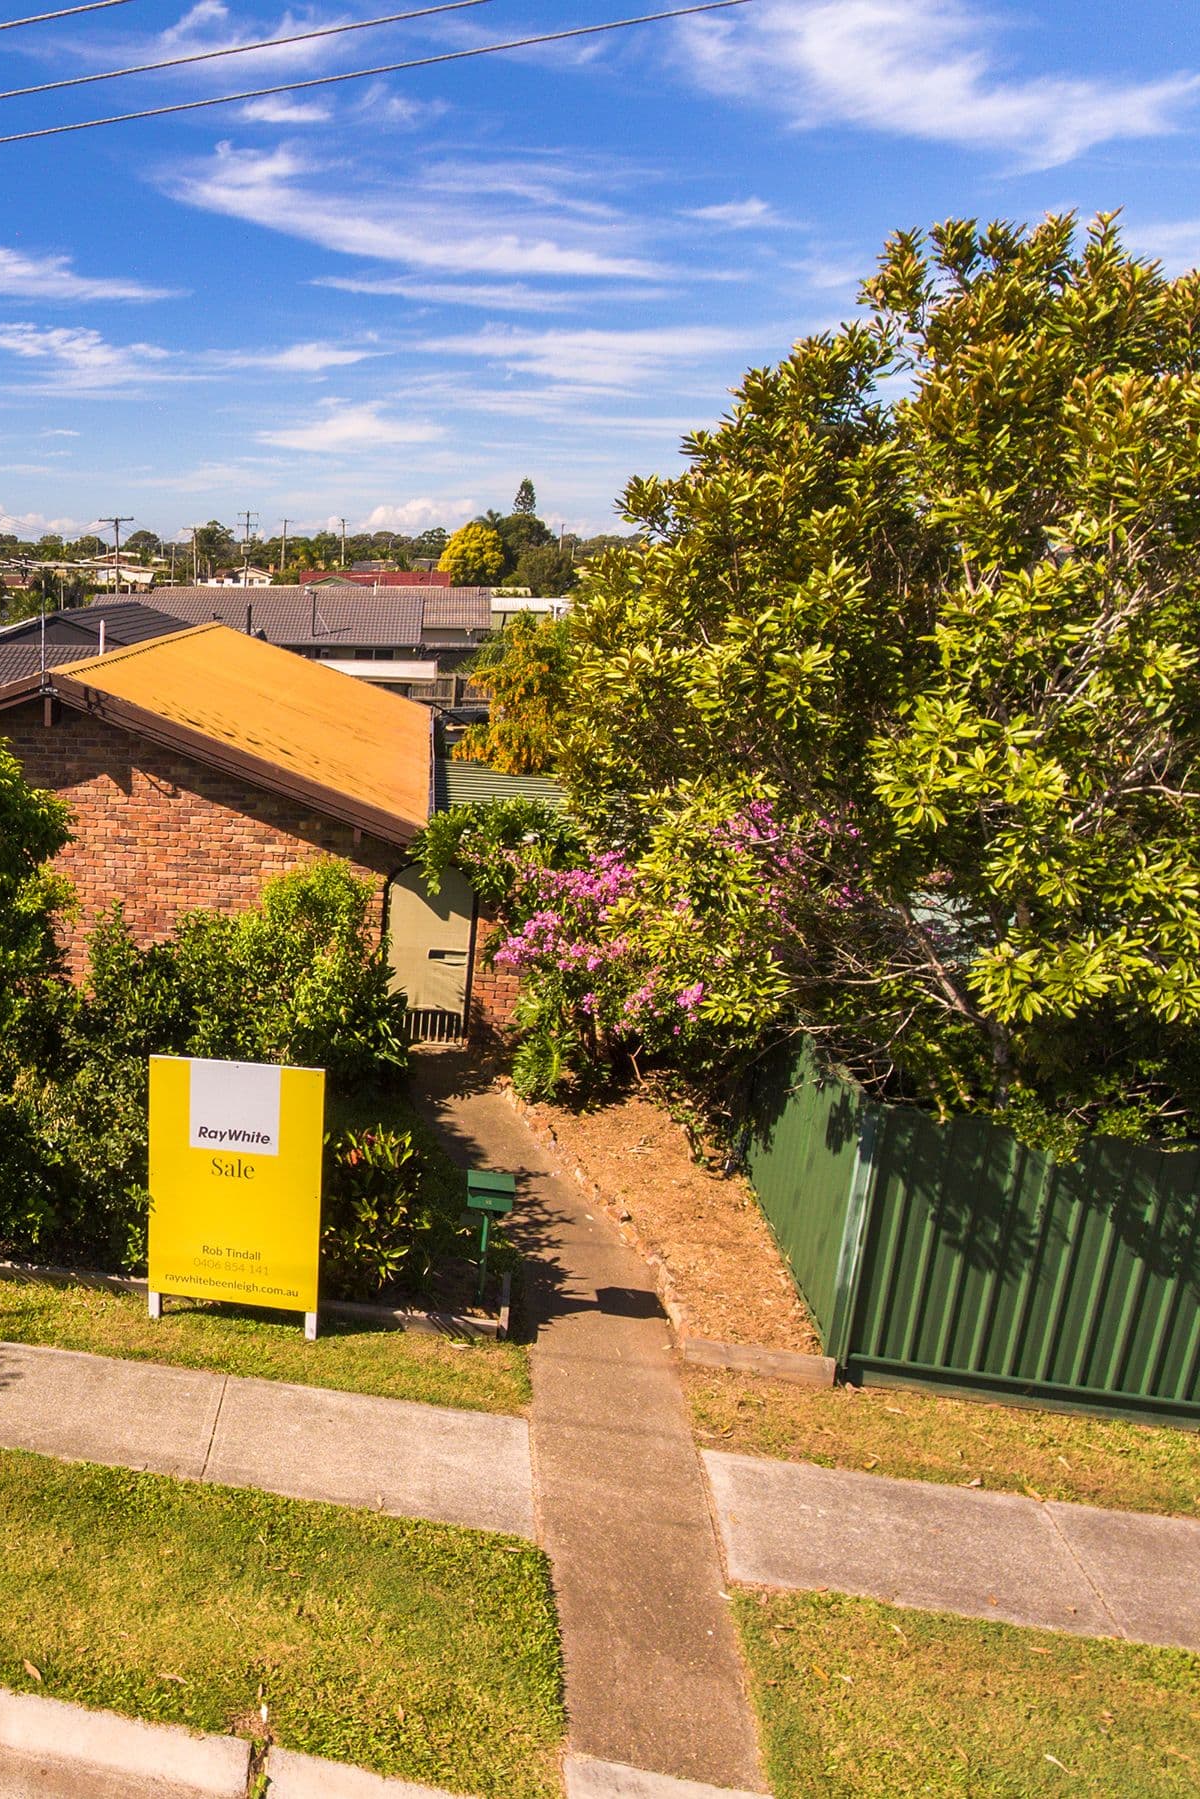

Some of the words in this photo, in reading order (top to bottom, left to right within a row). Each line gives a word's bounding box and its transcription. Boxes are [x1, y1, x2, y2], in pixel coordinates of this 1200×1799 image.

[211, 1157, 255, 1180] Sale
[202, 1245, 223, 1256] Rob
[225, 1248, 261, 1260] Tindall
[193, 1257, 221, 1270] 0406
[224, 1261, 246, 1273] 854
[249, 1264, 270, 1276] 141
[165, 1273, 299, 1298] raywhitebeenleigh.com.au
